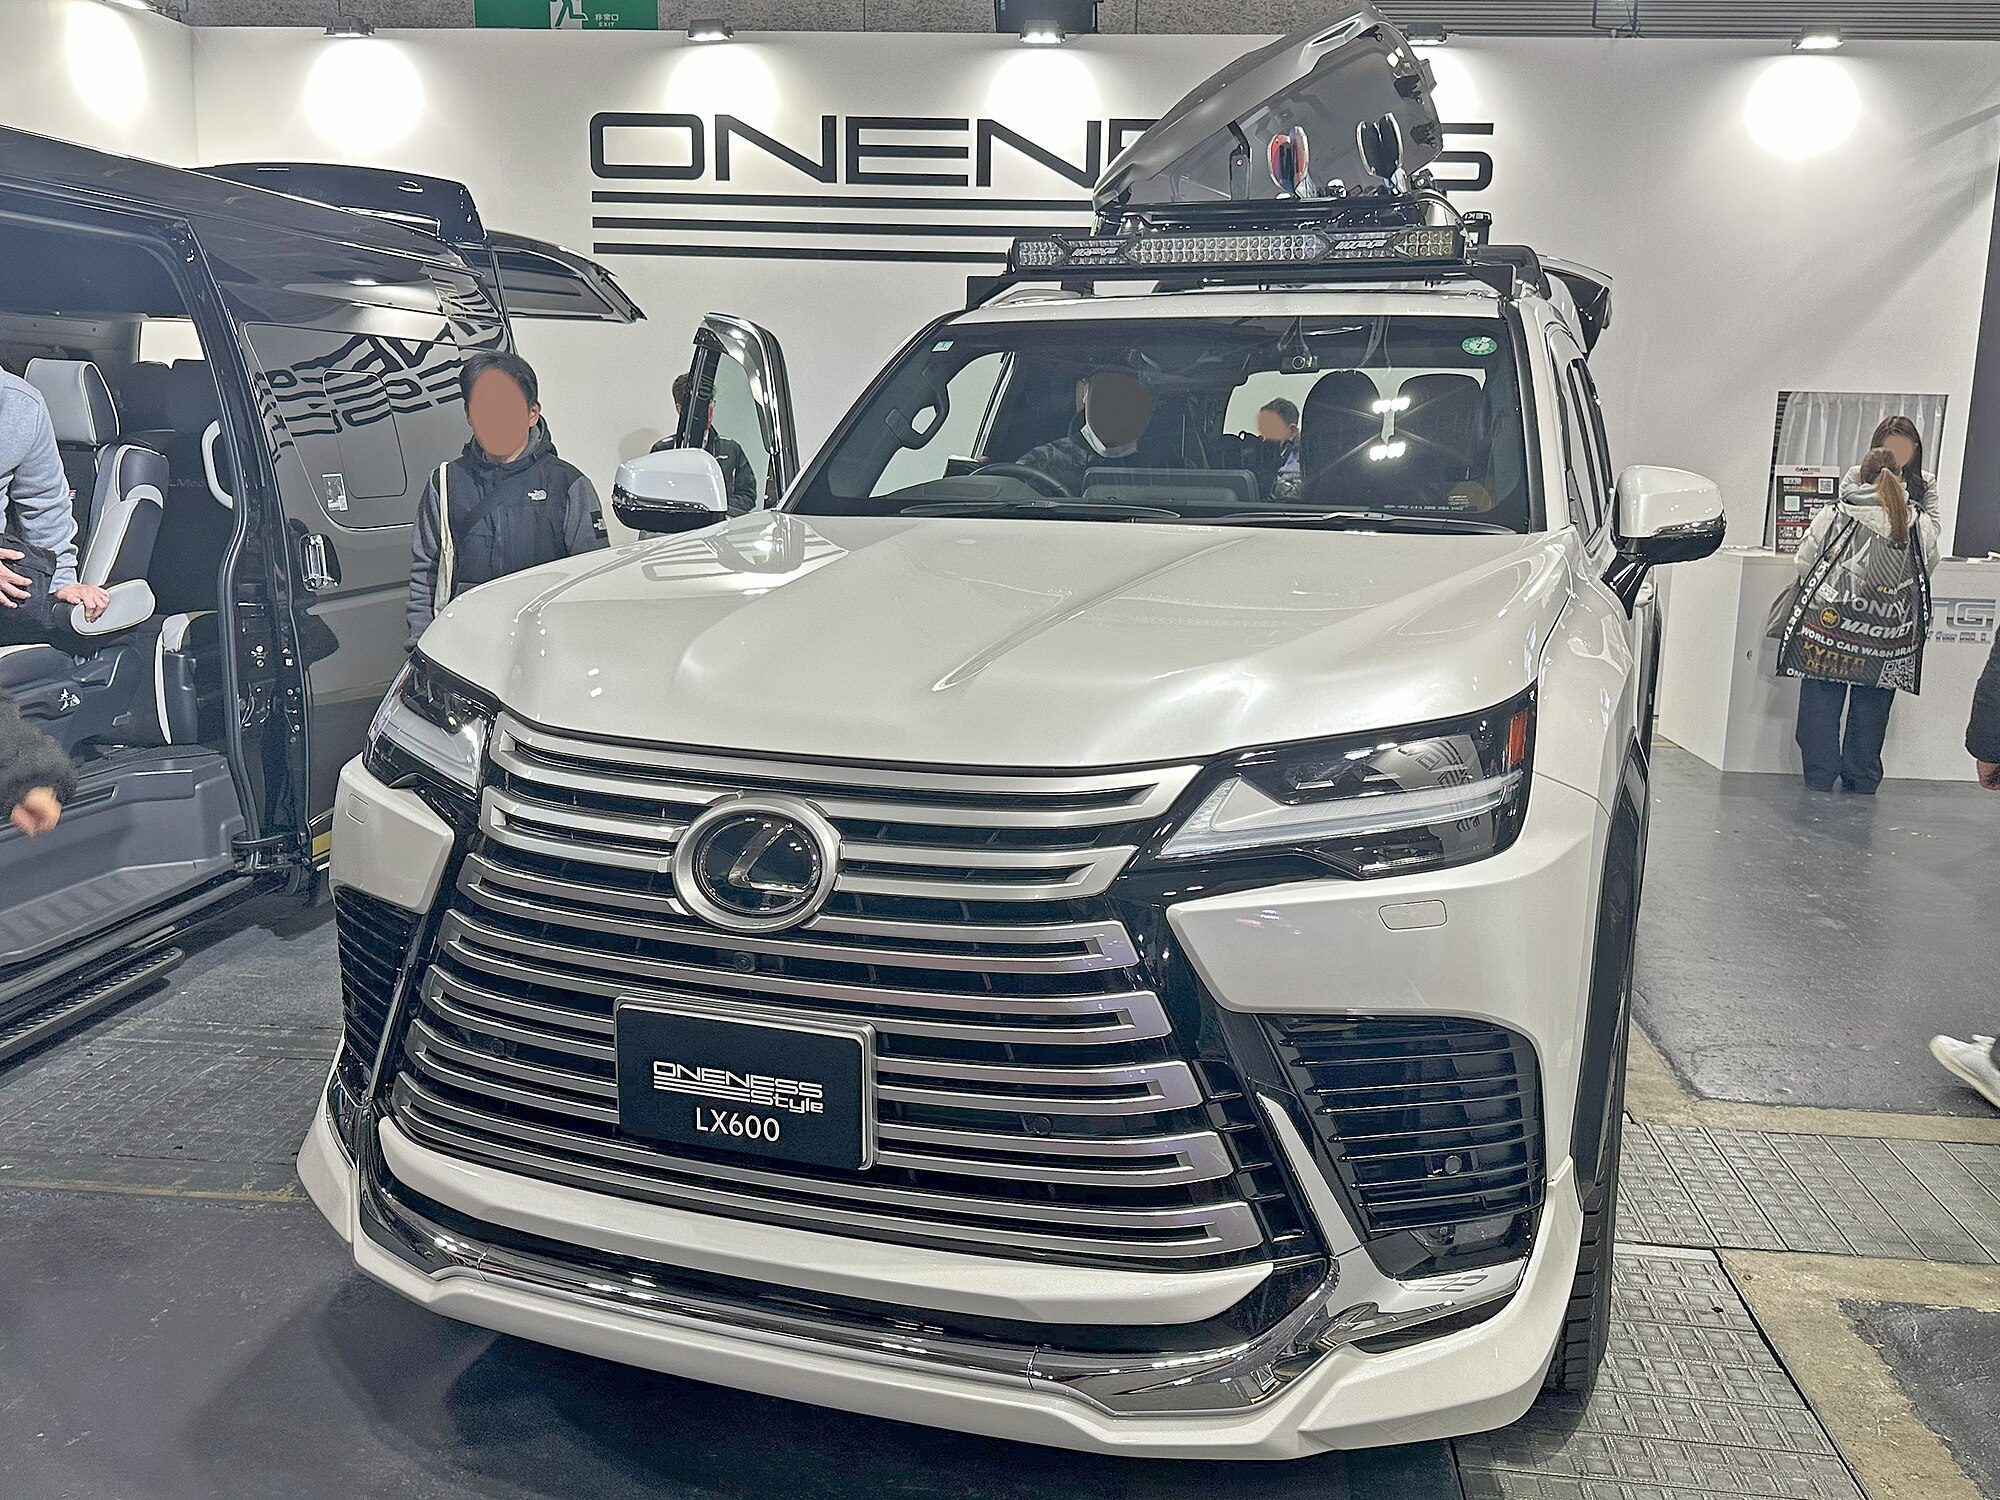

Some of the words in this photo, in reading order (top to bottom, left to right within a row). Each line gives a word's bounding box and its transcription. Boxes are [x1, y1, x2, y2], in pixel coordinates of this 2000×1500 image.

[595, 13, 619, 21] 非常口
[589, 112, 1494, 191] ONENS
[1801, 626, 1834, 647] WORLD
[1836, 640, 1859, 653] CAR
[1861, 647, 1893, 659] WASH
[1840, 617, 1913, 639] MAGWET
[653, 1060, 823, 1099] ONENESS
[750, 1090, 824, 1114] Style
[696, 1107, 780, 1143] LX600
